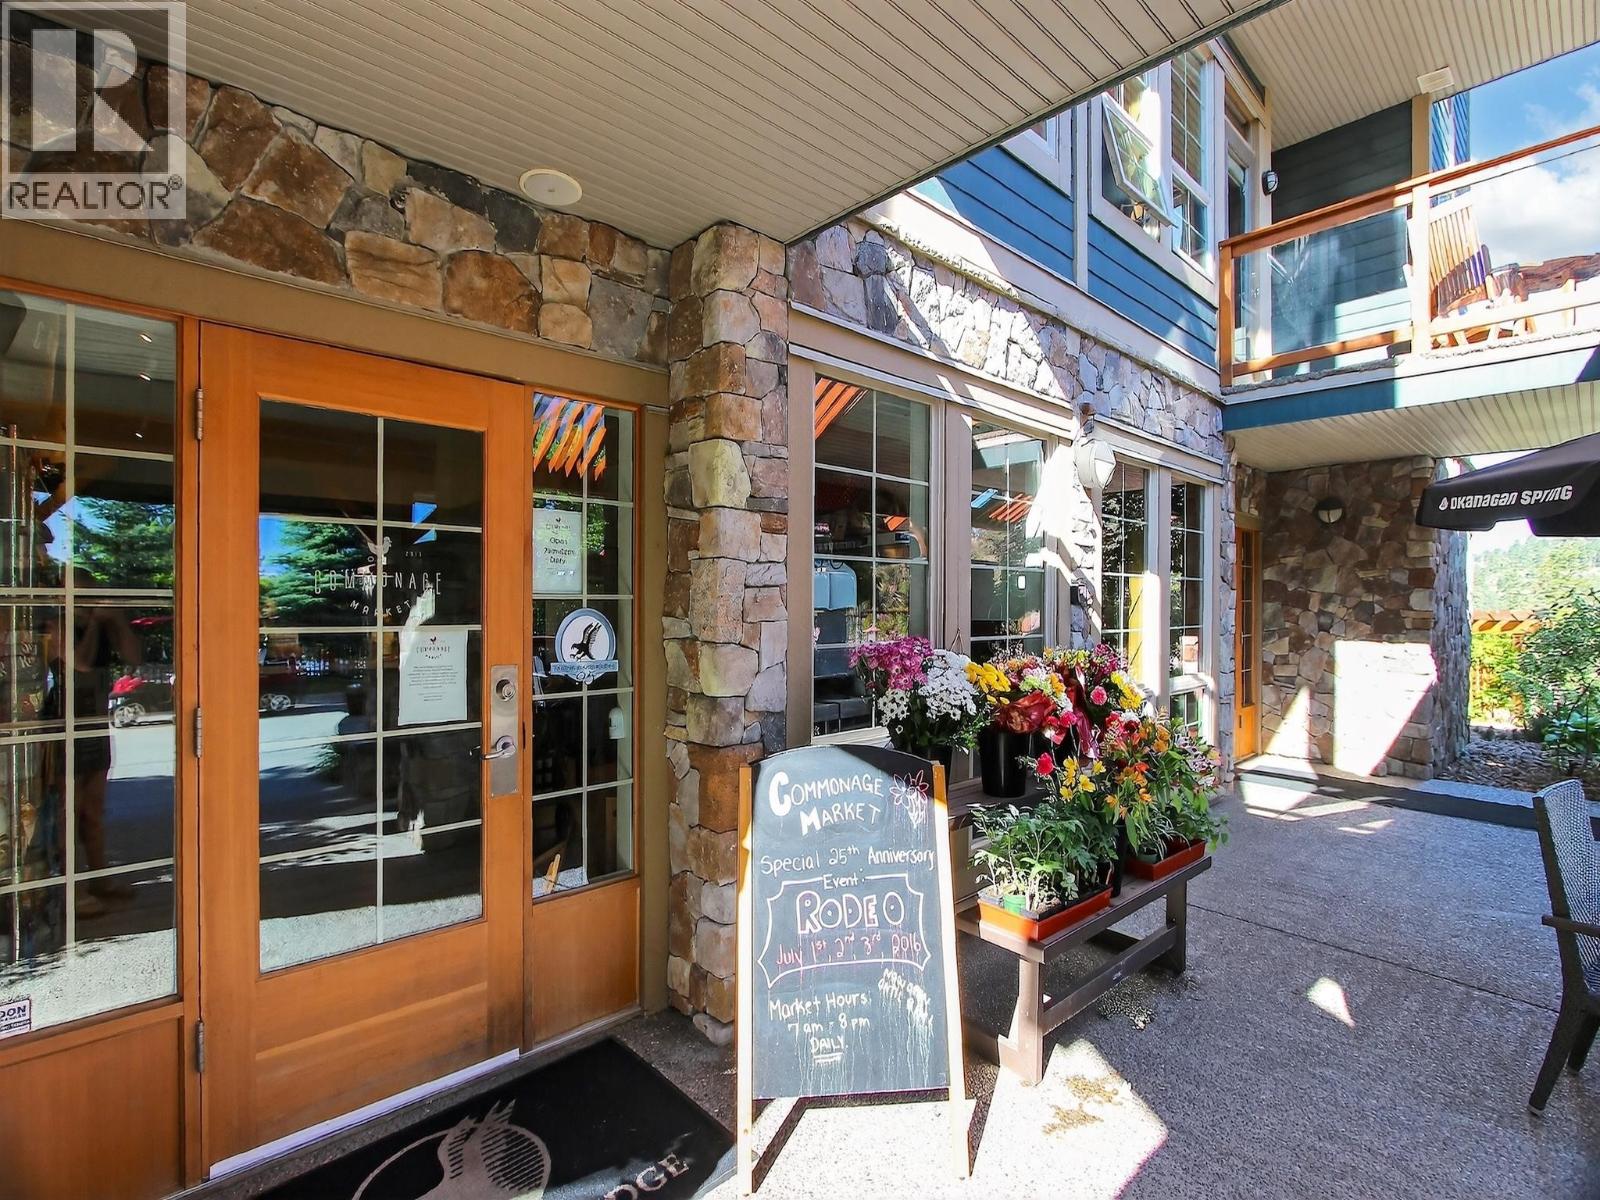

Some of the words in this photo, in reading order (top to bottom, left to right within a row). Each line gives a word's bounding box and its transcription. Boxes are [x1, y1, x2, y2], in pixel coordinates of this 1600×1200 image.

[768, 771, 884, 817] COMMONAGE
[799, 802, 881, 837] MARKET
[760, 853, 820, 877] Special
[828, 845, 860, 866] 25th
[796, 890, 905, 935] RODEO
[776, 944, 803, 968] July
[891, 932, 922, 954] 2016
[768, 995, 821, 1021] Market
